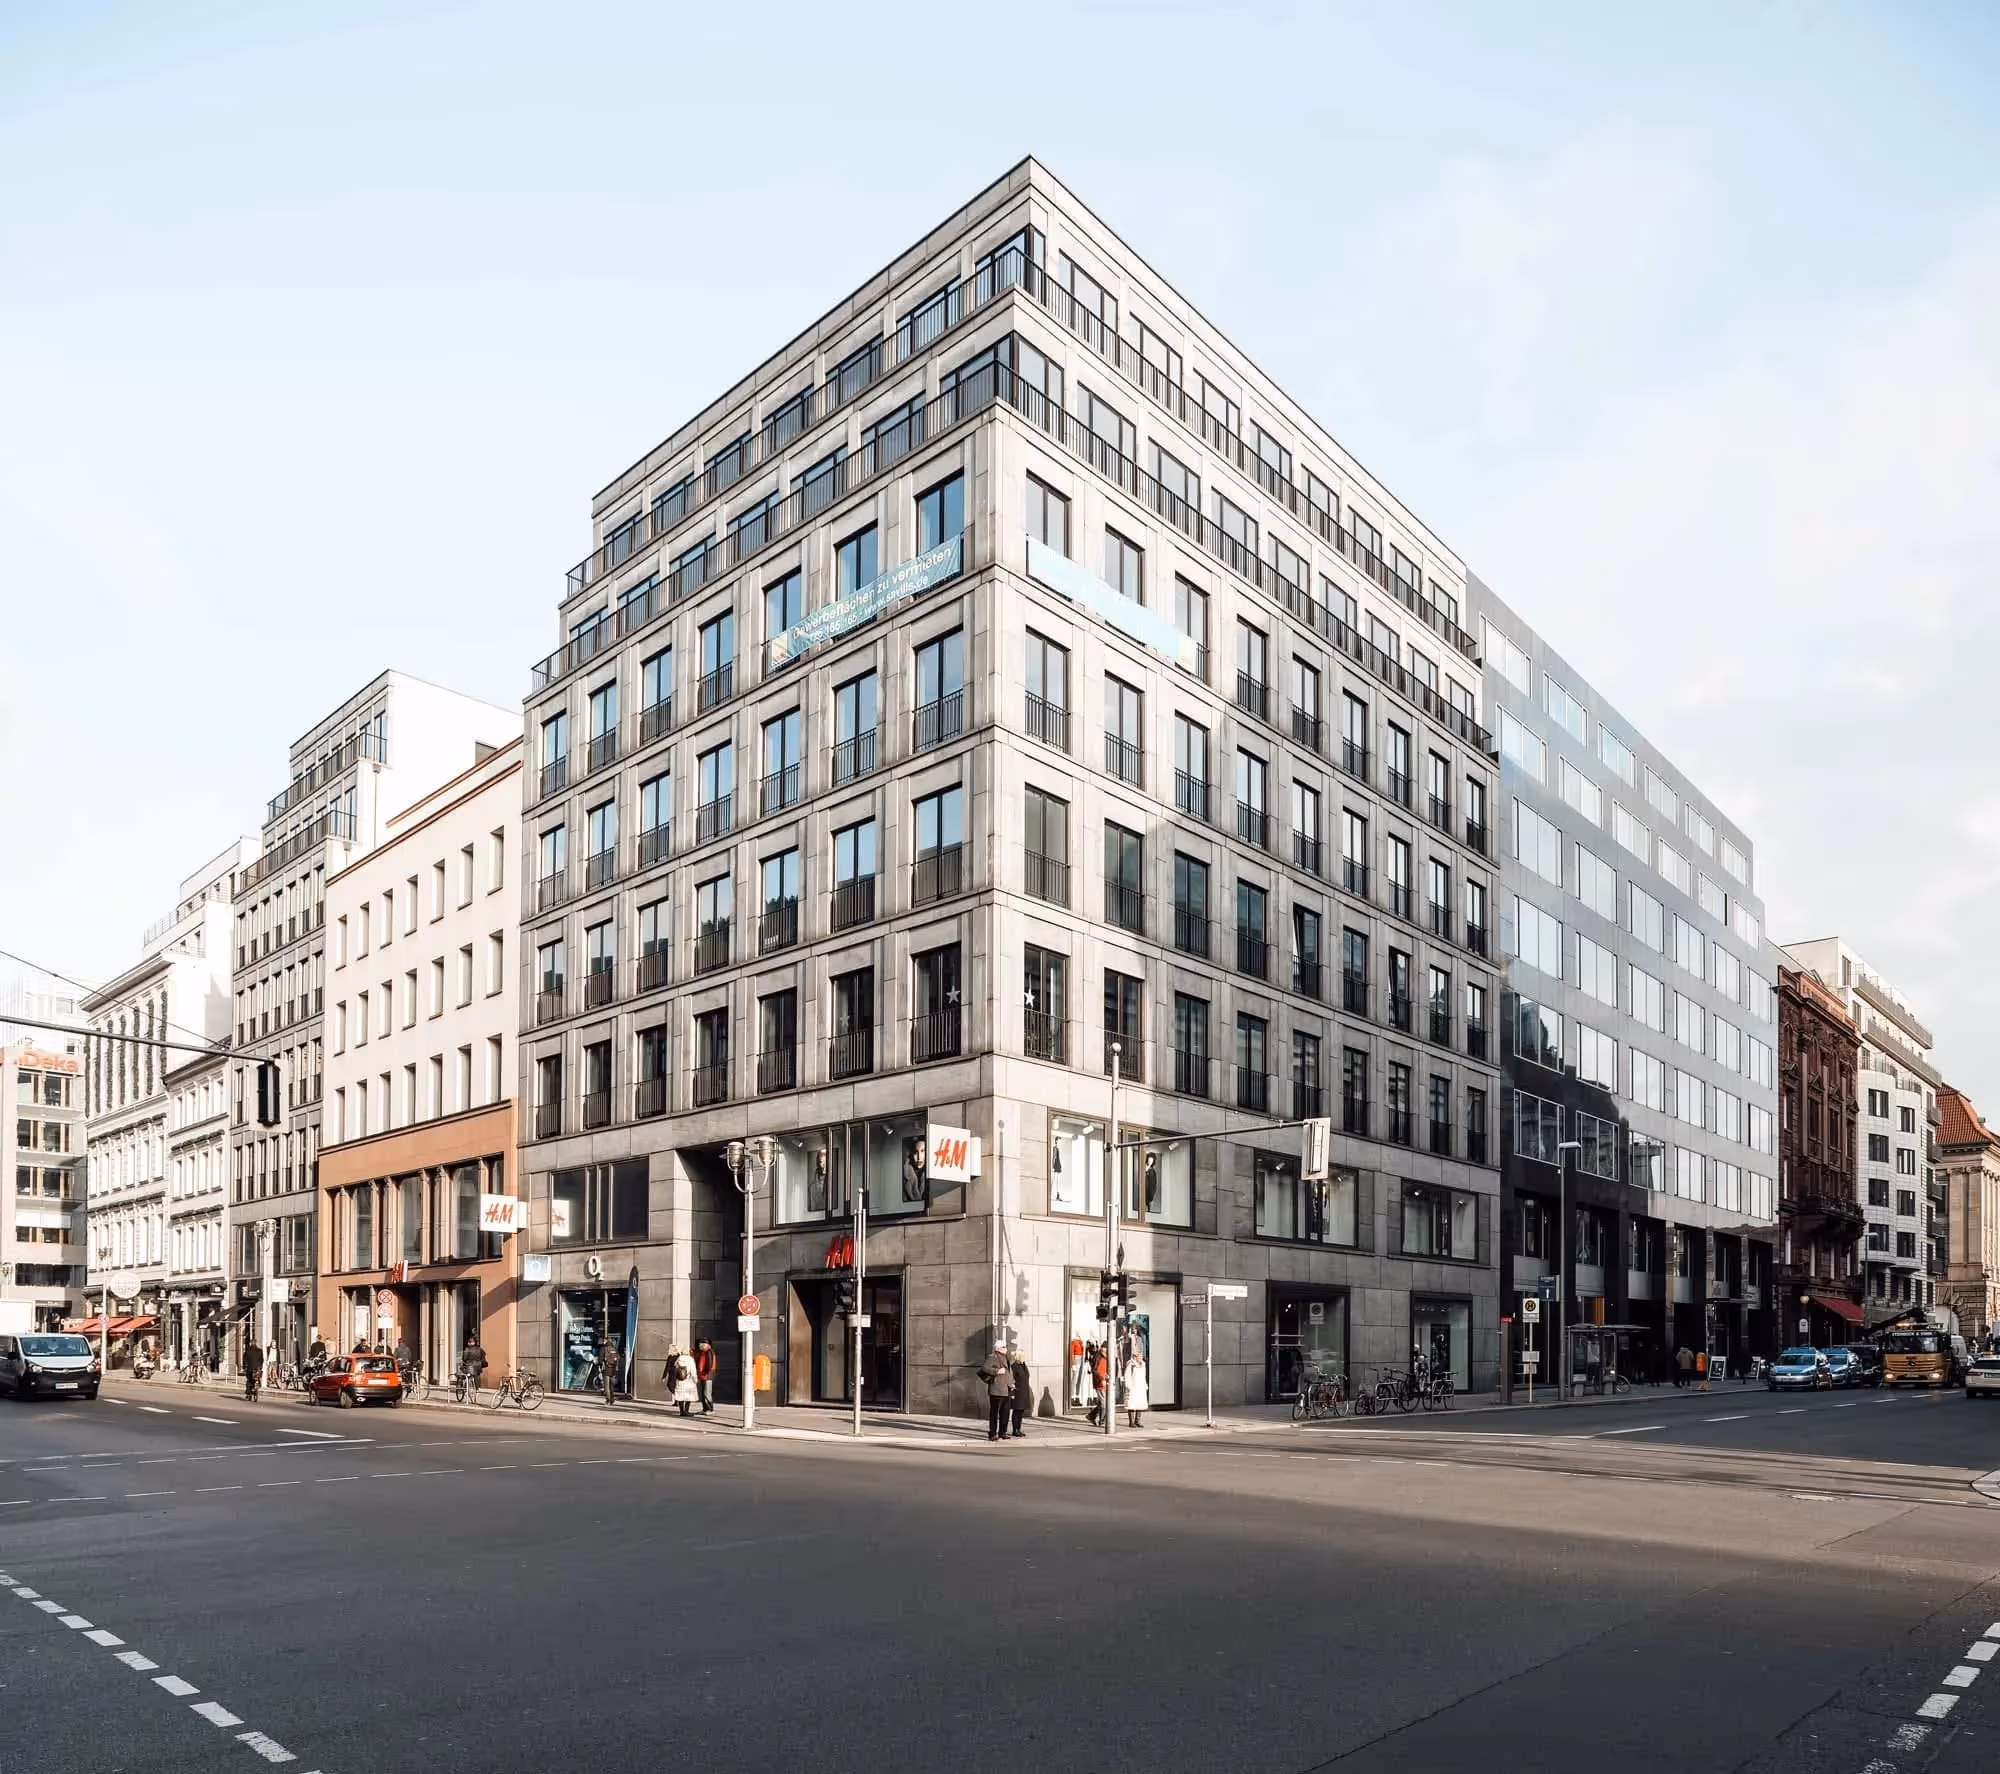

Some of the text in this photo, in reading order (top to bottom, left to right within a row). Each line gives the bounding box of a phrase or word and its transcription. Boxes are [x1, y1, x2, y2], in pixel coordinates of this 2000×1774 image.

[877, 581, 889, 593] zu
[892, 549, 951, 584] vermieten
[934, 1138, 967, 1170] H&M
[485, 1203, 514, 1224] H&M
